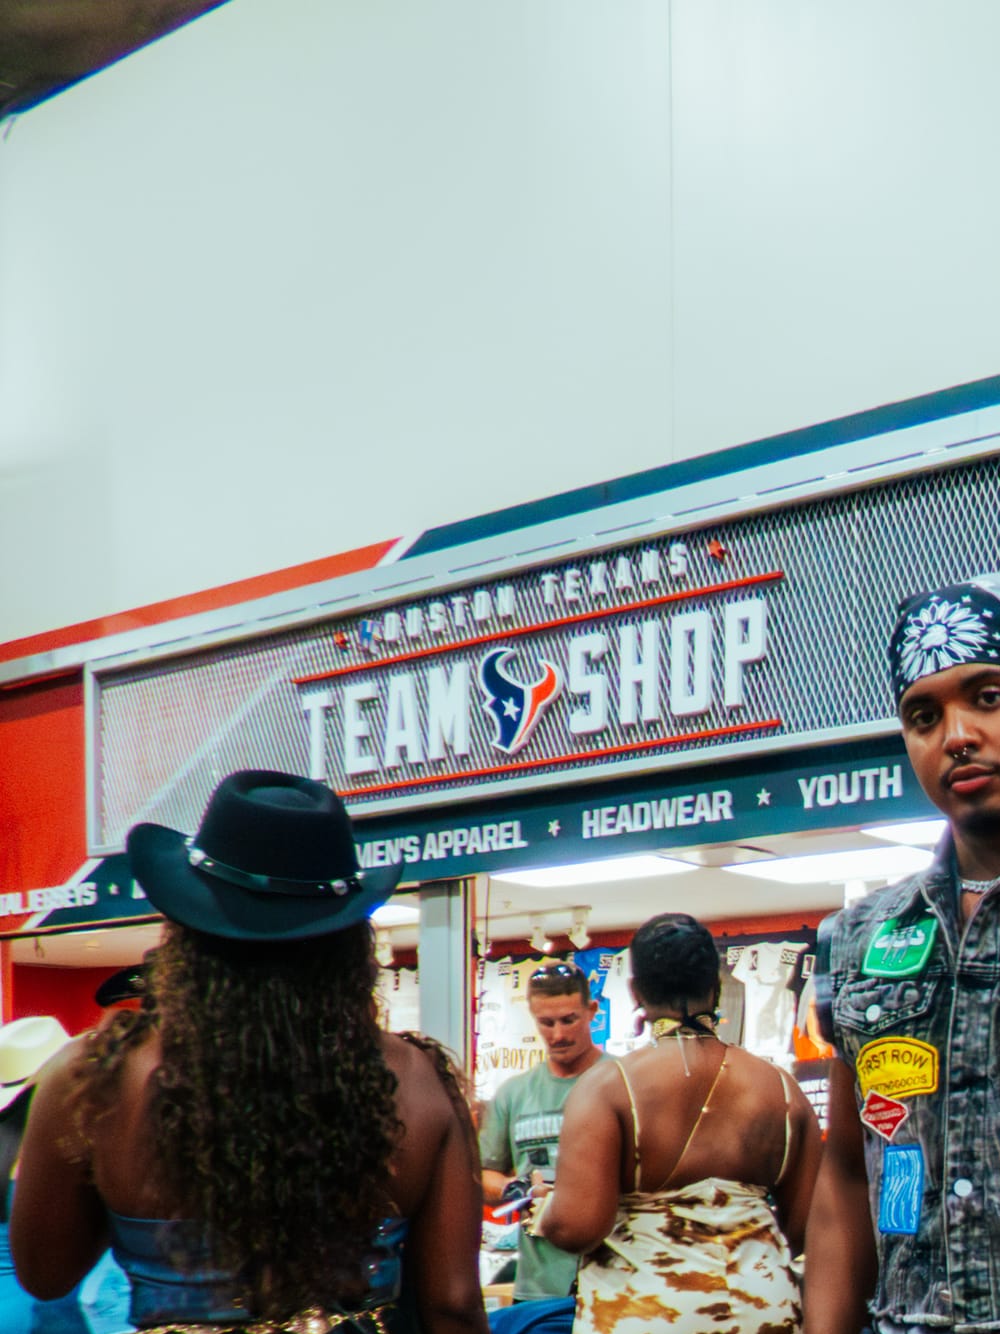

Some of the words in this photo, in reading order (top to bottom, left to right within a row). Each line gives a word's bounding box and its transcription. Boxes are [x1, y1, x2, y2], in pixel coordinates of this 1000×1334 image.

[359, 585, 515, 655] HOUSTON
[542, 543, 687, 604] TEXANS
[302, 661, 471, 780] TEAM
[568, 598, 767, 735] SHOP
[798, 765, 903, 809] YOUTH
[582, 790, 735, 839] HEADWEAR
[422, 820, 528, 860] APPAREL
[891, 1049, 928, 1069] ROW
